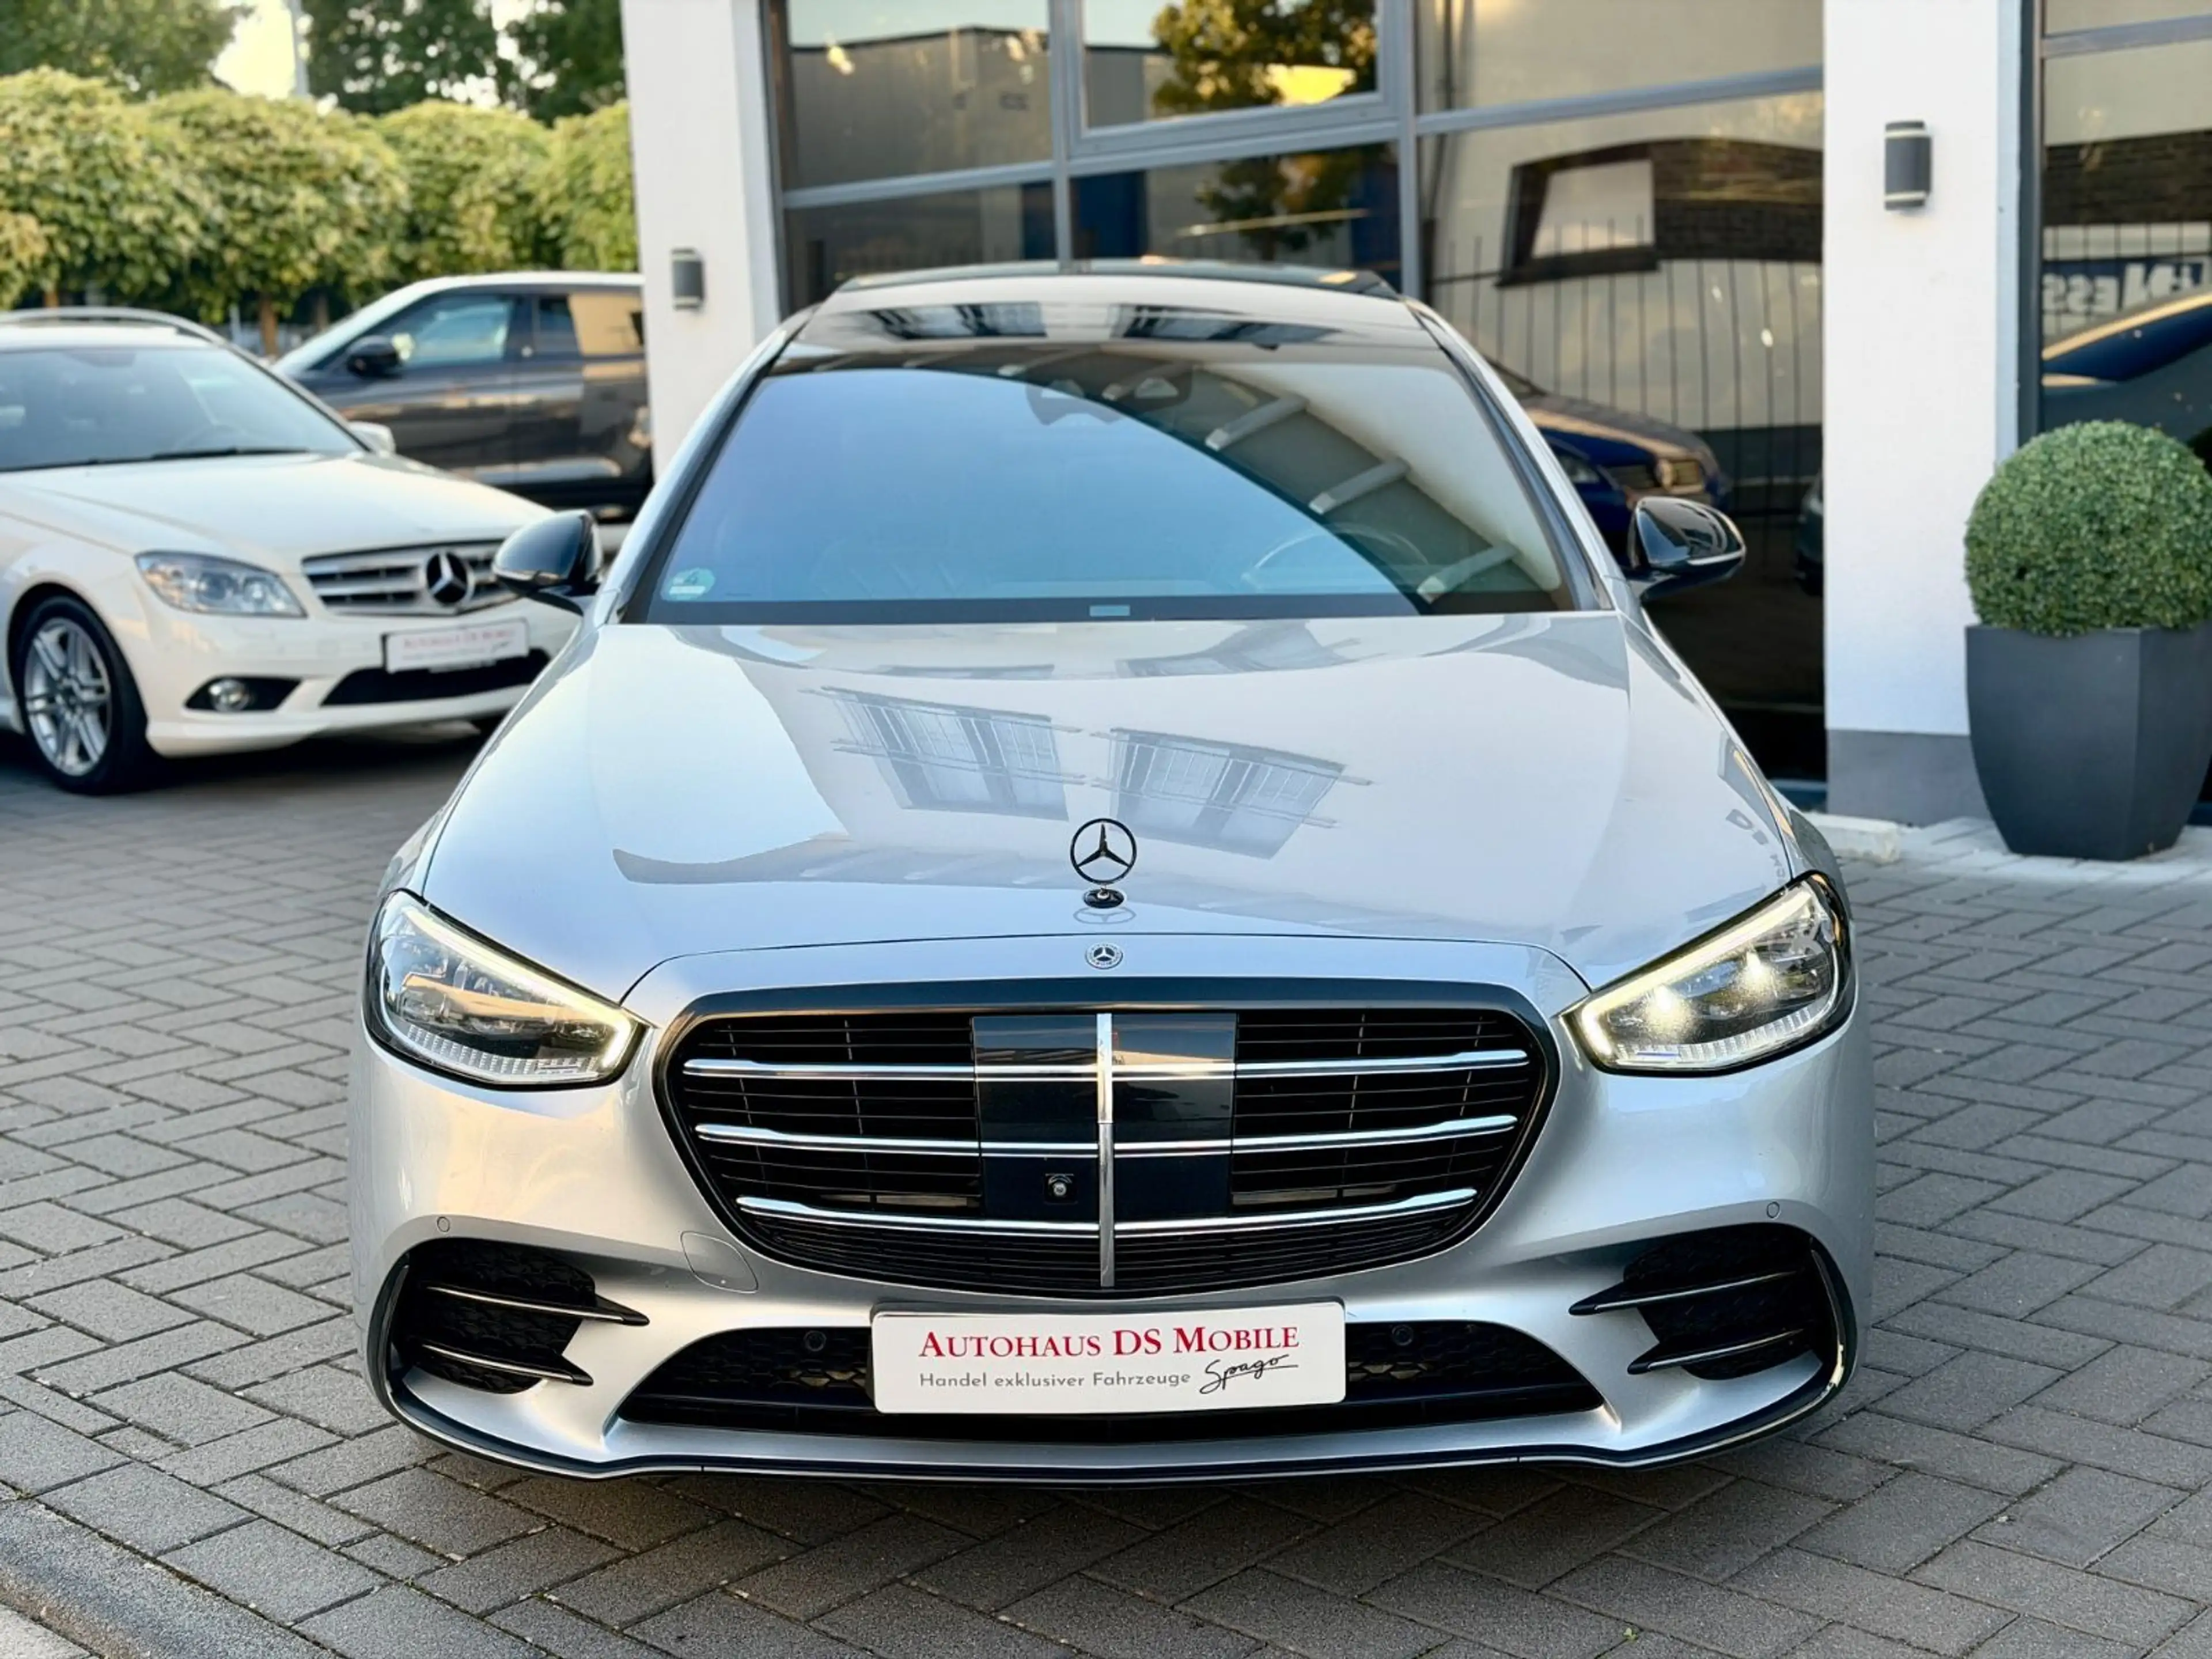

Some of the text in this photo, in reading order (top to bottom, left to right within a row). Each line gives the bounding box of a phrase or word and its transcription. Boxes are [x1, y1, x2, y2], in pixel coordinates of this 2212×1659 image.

[918, 1327, 1299, 1358] AUTOHAUS DS MOBILE
[921, 1371, 1191, 1387] Handel exklusiver Fahrzeuge
[1199, 1354, 1299, 1394] Spago
